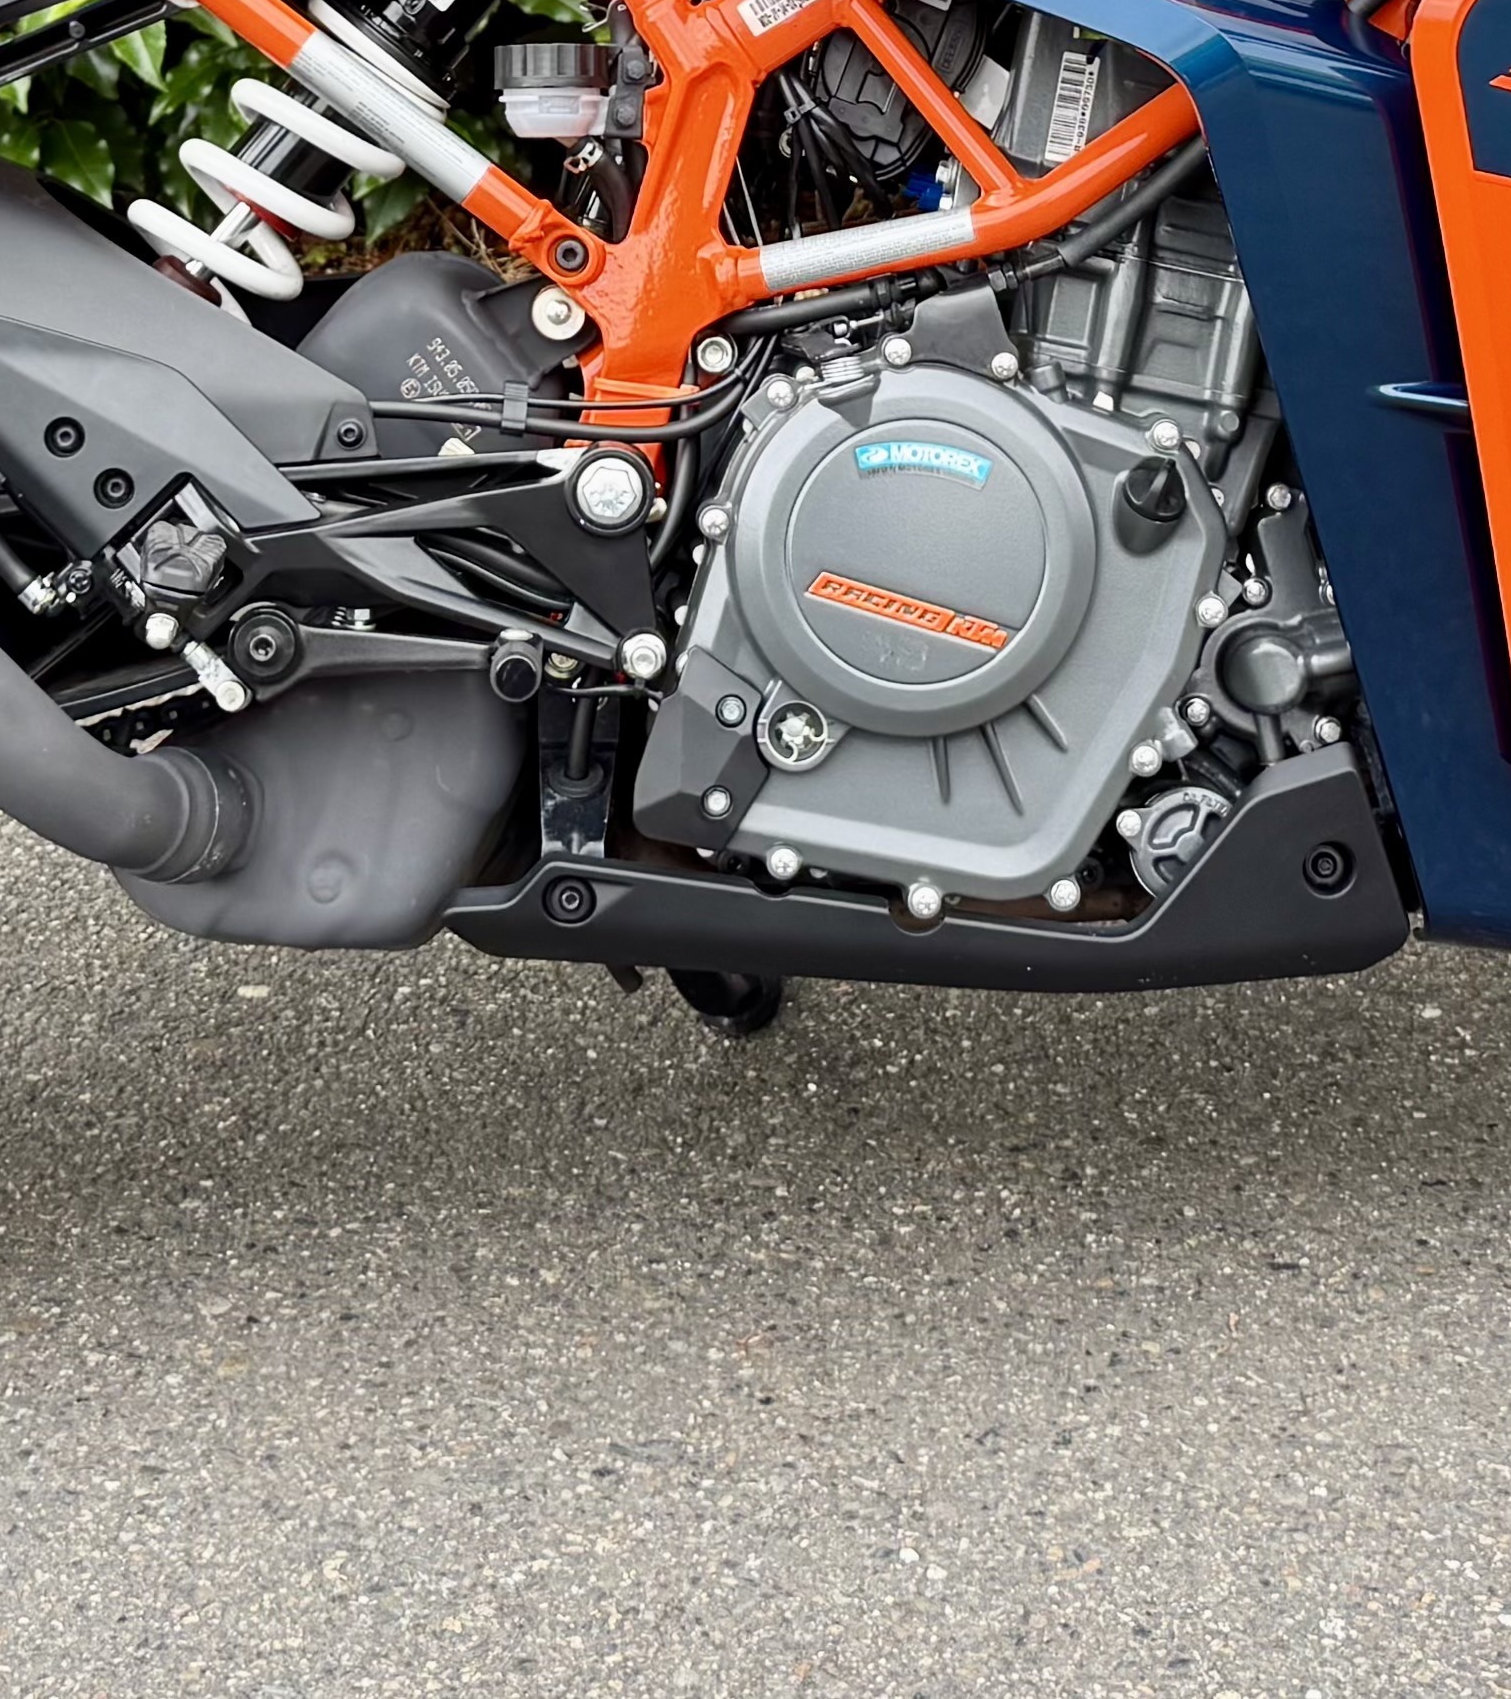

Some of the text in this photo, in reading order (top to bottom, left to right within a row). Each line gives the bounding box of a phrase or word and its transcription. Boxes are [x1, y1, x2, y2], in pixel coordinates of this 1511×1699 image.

[405, 352, 430, 378] KTM
[890, 444, 982, 478] MOTOREX
[821, 579, 1009, 648] RACING KTM
